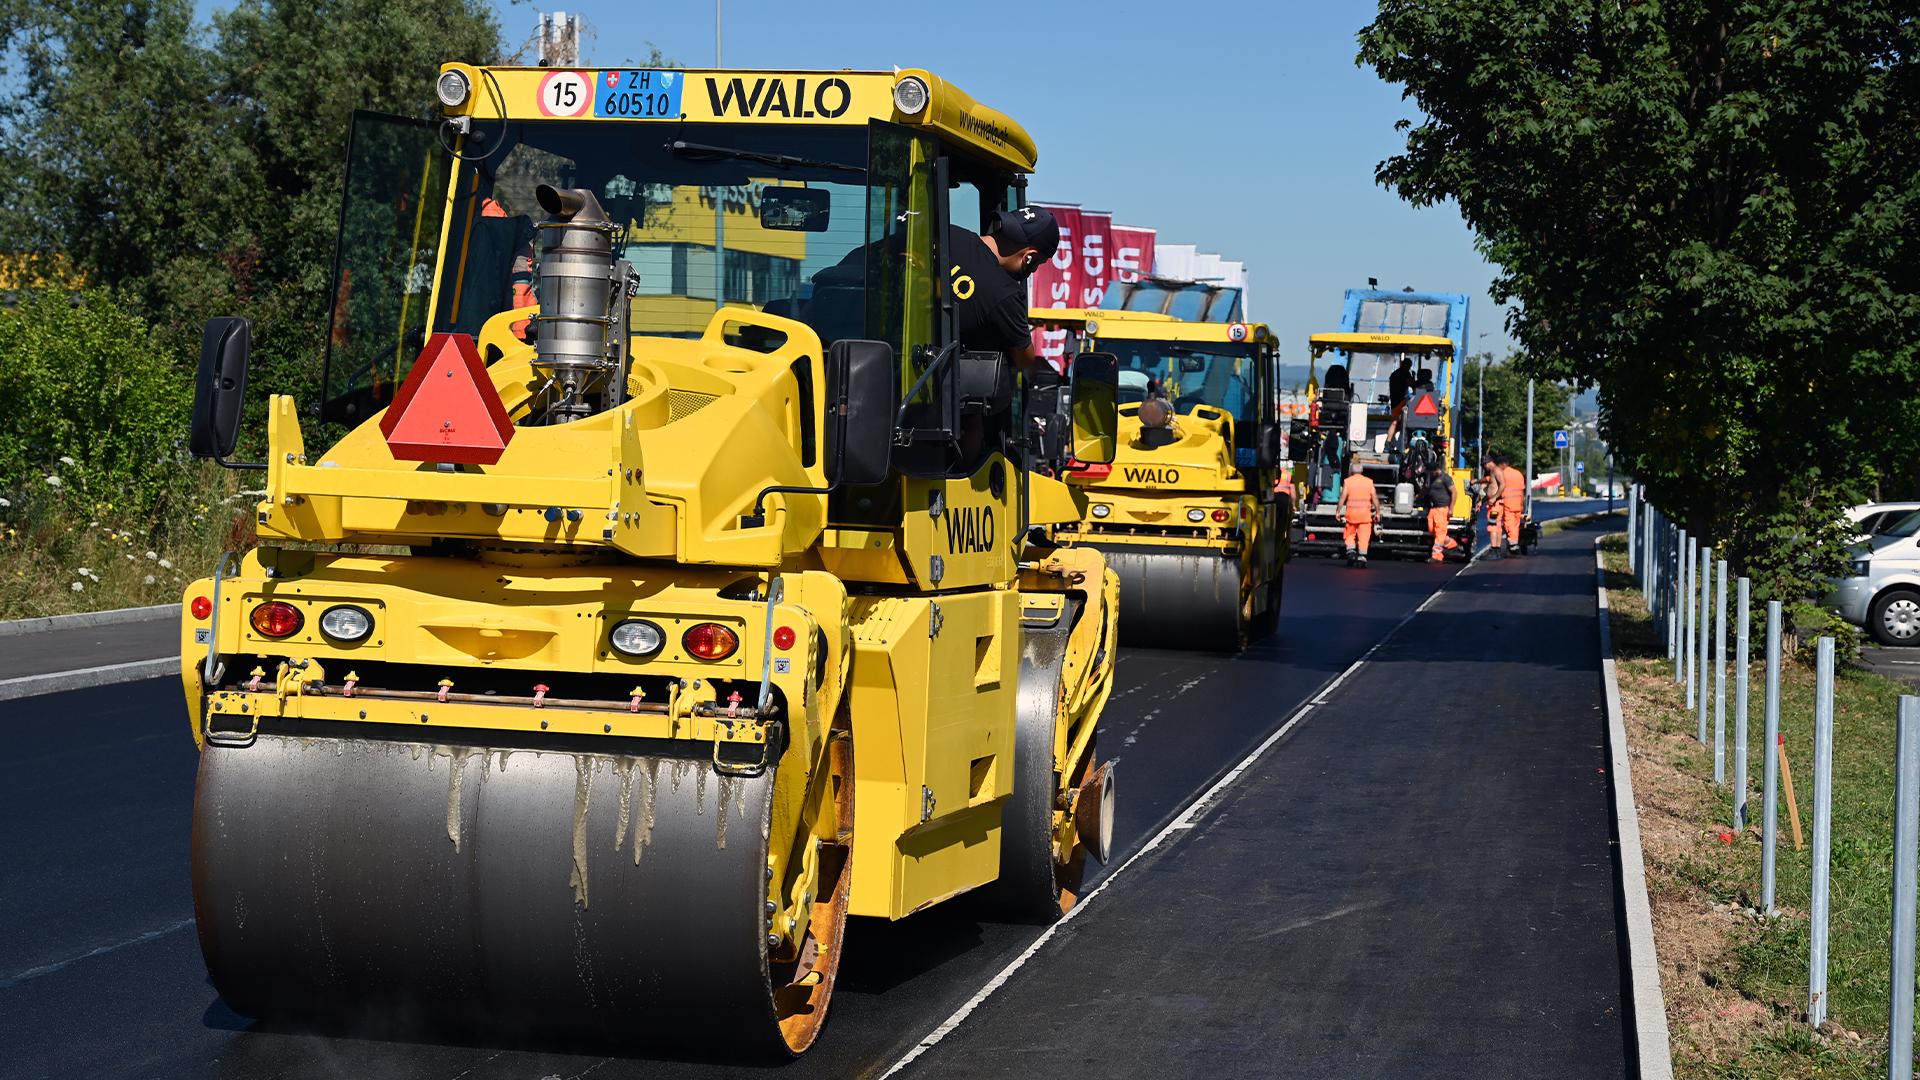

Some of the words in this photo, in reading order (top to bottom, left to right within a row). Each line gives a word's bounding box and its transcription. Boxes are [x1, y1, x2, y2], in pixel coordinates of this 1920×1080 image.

[629, 71, 650, 89] ZH
[553, 82, 578, 107] 15
[605, 92, 670, 115] 60510
[704, 77, 852, 118] WALO
[1083, 234, 1104, 310] s.ch
[1233, 328, 1242, 337] 15
[1123, 467, 1179, 484] WALO
[945, 505, 994, 554] WALO
